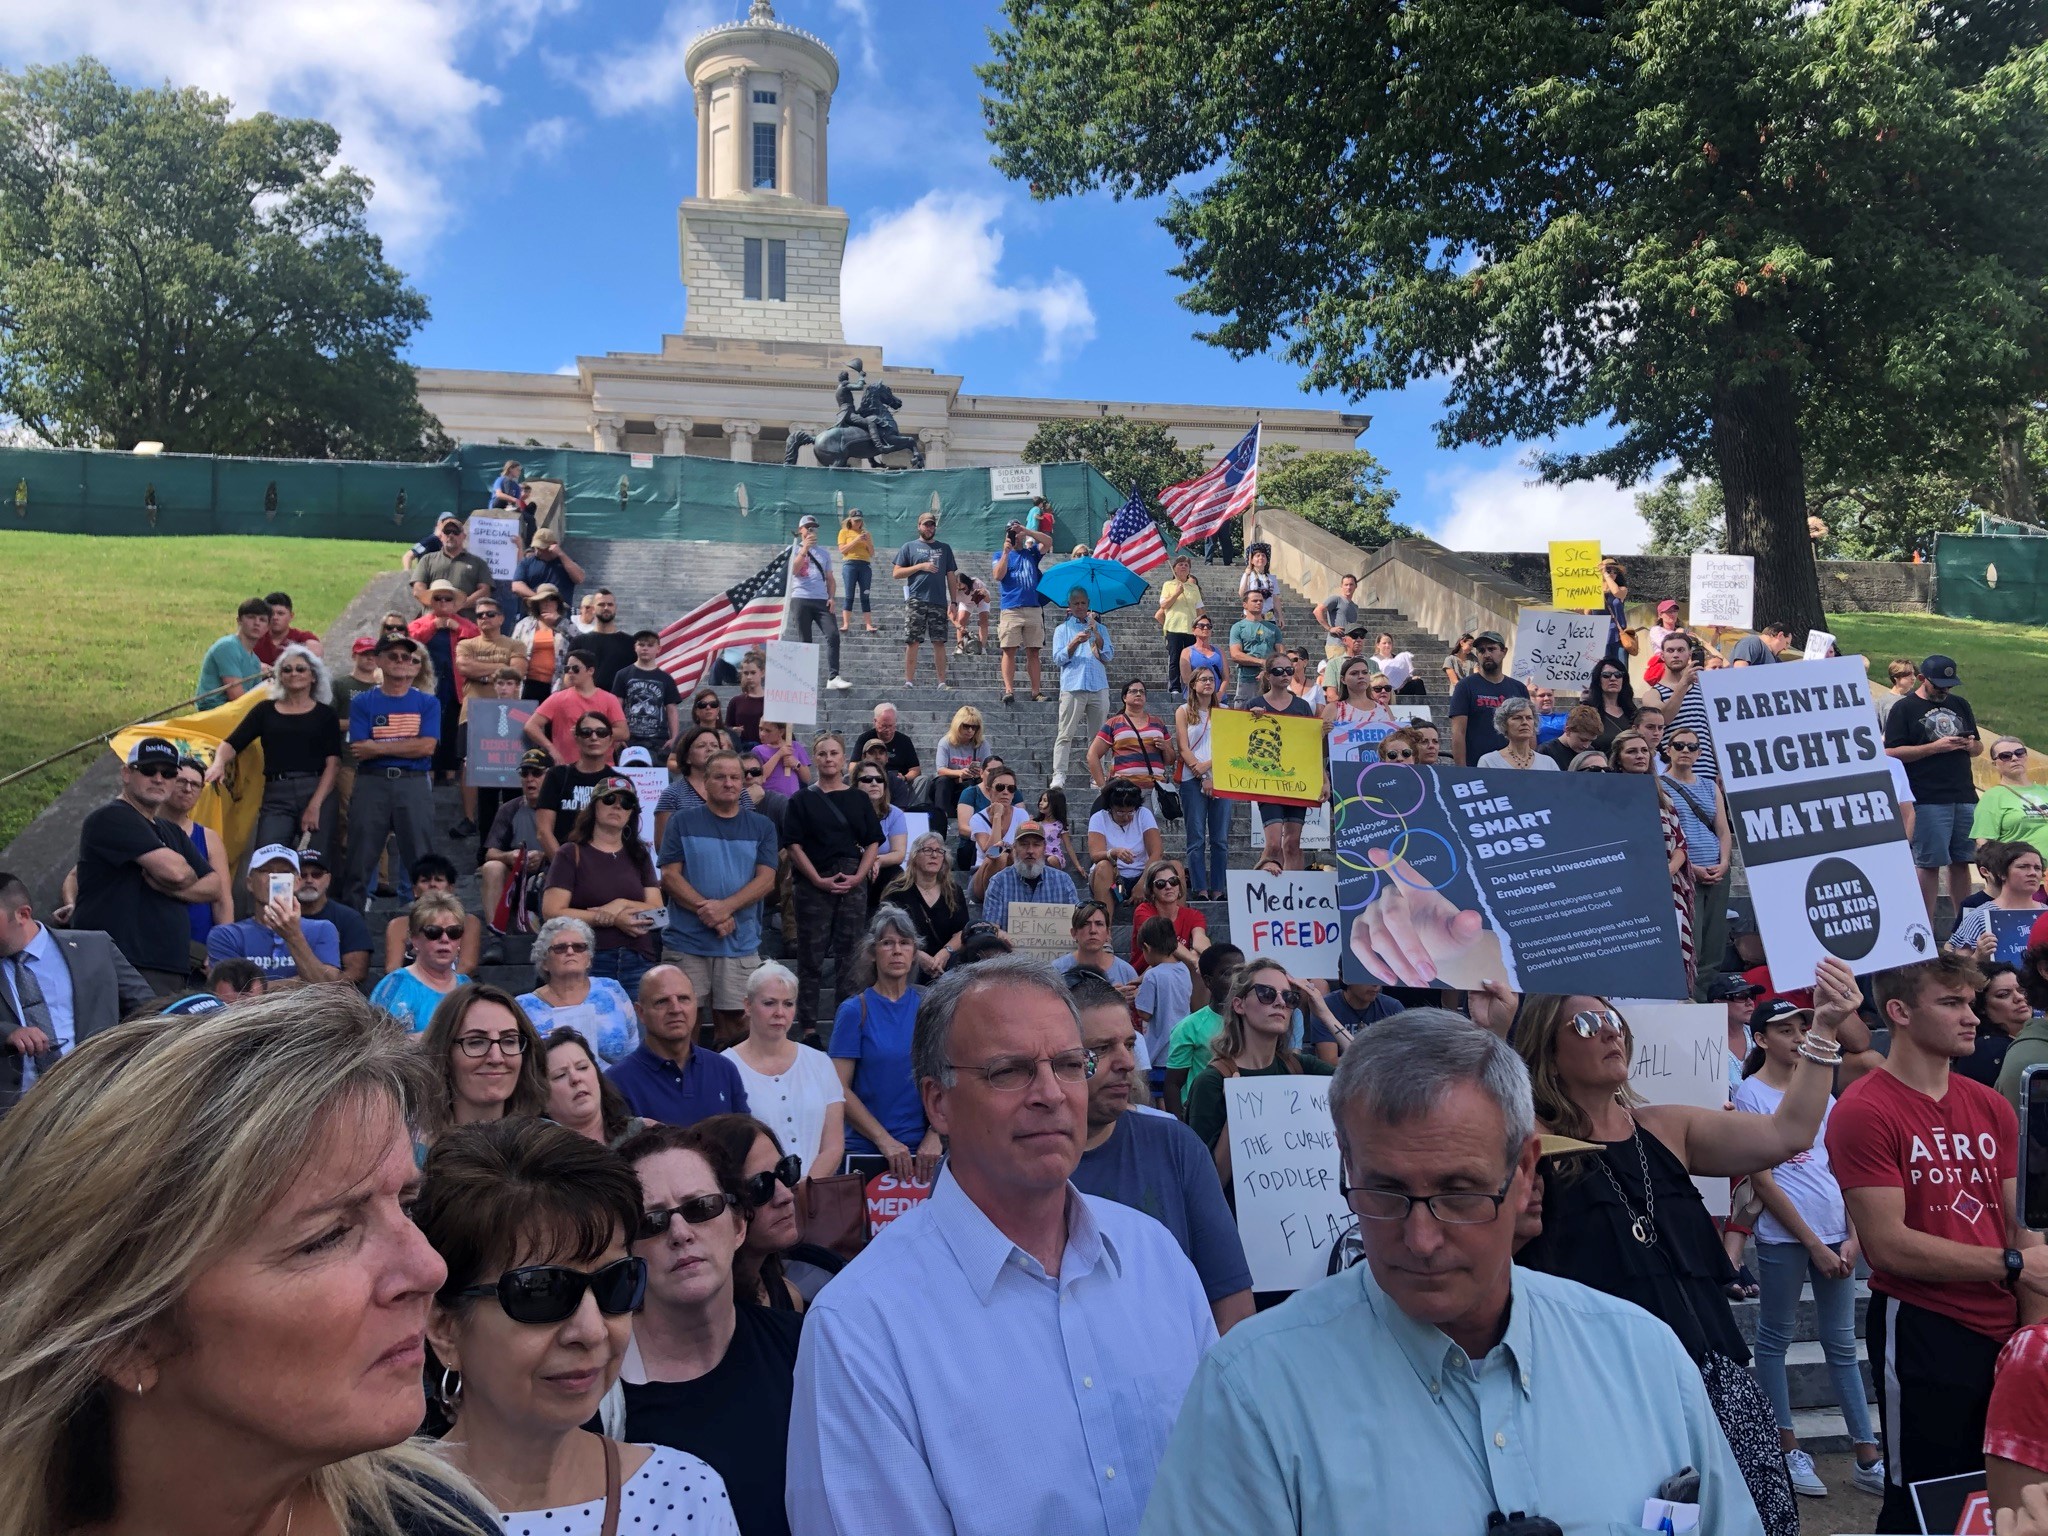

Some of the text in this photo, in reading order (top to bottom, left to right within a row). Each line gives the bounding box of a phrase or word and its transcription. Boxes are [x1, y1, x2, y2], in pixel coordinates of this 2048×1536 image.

[998, 468, 1033, 476] SIDEWALK
[473, 528, 513, 538] SPECIAL
[1565, 548, 1592, 561] SIC
[1556, 567, 1599, 579] SEMPER
[1707, 561, 1744, 572] Protect
[1556, 585, 1602, 600] TYRANNIS
[1702, 580, 1748, 589] FREEDOMS!
[1700, 605, 1740, 615] SESSION
[1701, 599, 1744, 608] SPECIAL
[1536, 619, 1594, 638] We Need
[1557, 639, 1566, 650] a
[1531, 648, 1580, 668] Special
[766, 689, 817, 705] MANDATES
[1714, 682, 1866, 722] PARENTAL
[1725, 726, 1877, 779] RIGHTS
[1272, 779, 1307, 792] TREAD
[1377, 779, 1397, 789] Trust
[1452, 780, 1488, 798] BE
[1460, 796, 1513, 818] THE
[1741, 790, 1894, 844] MATTER
[1341, 820, 1388, 836] Employee
[1468, 809, 1552, 838] SMART
[1336, 824, 1400, 848] Engagement
[1476, 833, 1546, 860] BOSS
[1410, 854, 1437, 867] Loyalty
[1490, 852, 1626, 886] Do Not Fire Unvaccinated
[1247, 882, 1340, 914] Medical
[1496, 880, 1556, 899] Employees
[1814, 880, 1862, 900] LEAVE
[1504, 886, 1623, 916] Vaccinated employees can still
[1808, 895, 1878, 921] OUR KIDS
[1018, 906, 1069, 918] WE ARE
[1509, 900, 1614, 928] contract and spread Covid.
[1253, 920, 1340, 952] FREEDO
[1517, 914, 1650, 950] Unvaccinated employees who had
[1824, 914, 1872, 938] ALONE
[1522, 925, 1662, 960] Covid have antibody immunity more
[1526, 937, 1663, 972] powerful than the Covid treatment.
[1628, 1036, 1722, 1082] ALL MY
[1236, 1092, 1264, 1120] MY
[1241, 1133, 1273, 1160] THE
[1243, 1168, 1334, 1197] TODDLER
